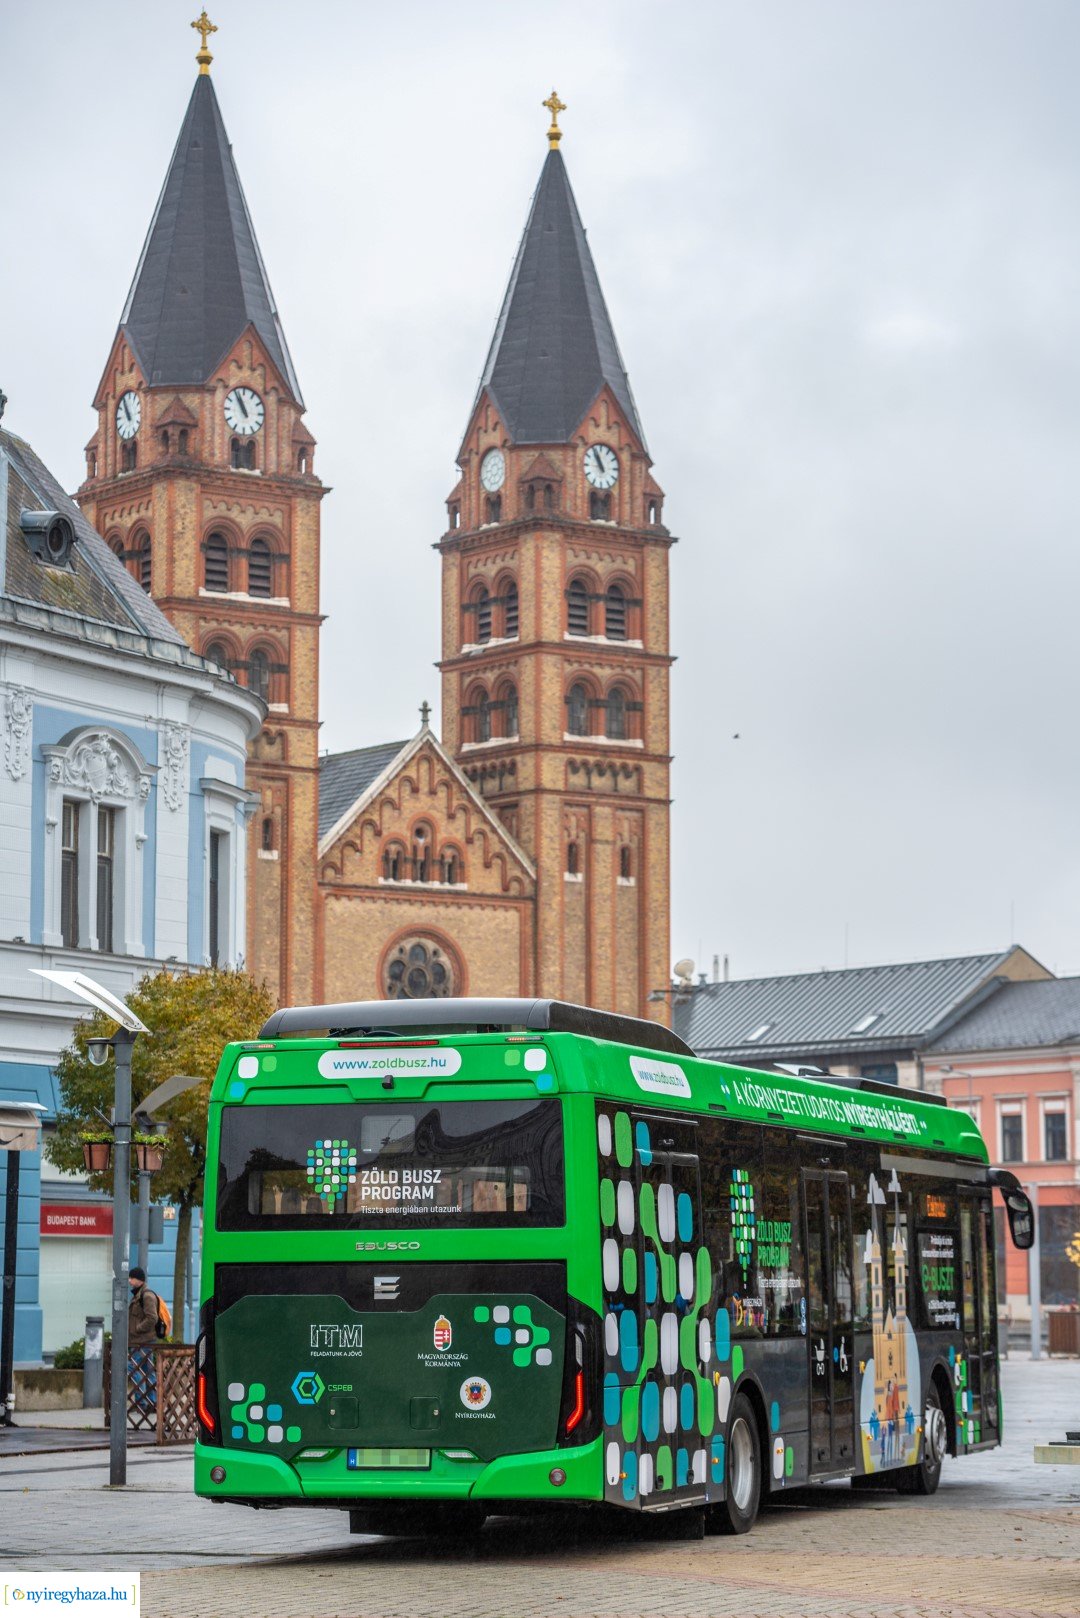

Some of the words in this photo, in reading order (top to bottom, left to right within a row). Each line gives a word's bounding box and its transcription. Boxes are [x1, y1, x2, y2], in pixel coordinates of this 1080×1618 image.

[333, 1056, 447, 1071] www.zoldbusz.hu
[732, 1080, 743, 1104] A
[741, 1076, 846, 1123] KÖRNYEZETTUDATOS
[840, 1097, 921, 1136] NYÍREGYHÁZÁÉRT!
[361, 1167, 398, 1184] ZÖLD
[402, 1169, 442, 1184] BUSZ
[361, 1185, 434, 1200] PROGRAM
[361, 1205, 384, 1214] Tiszta
[385, 1205, 428, 1215] energiában
[430, 1205, 462, 1213] utazunk
[46, 1215, 79, 1226] BUDAPEST
[79, 1216, 96, 1227] BANK
[756, 1215, 774, 1242] ZÖLD
[774, 1221, 792, 1243] BUSZ
[355, 1241, 421, 1251] EBUSCO
[757, 1245, 790, 1267] PROGRAM
[310, 1324, 363, 1348] ITM
[417, 1352, 469, 1360] MAGYARORSZÁG
